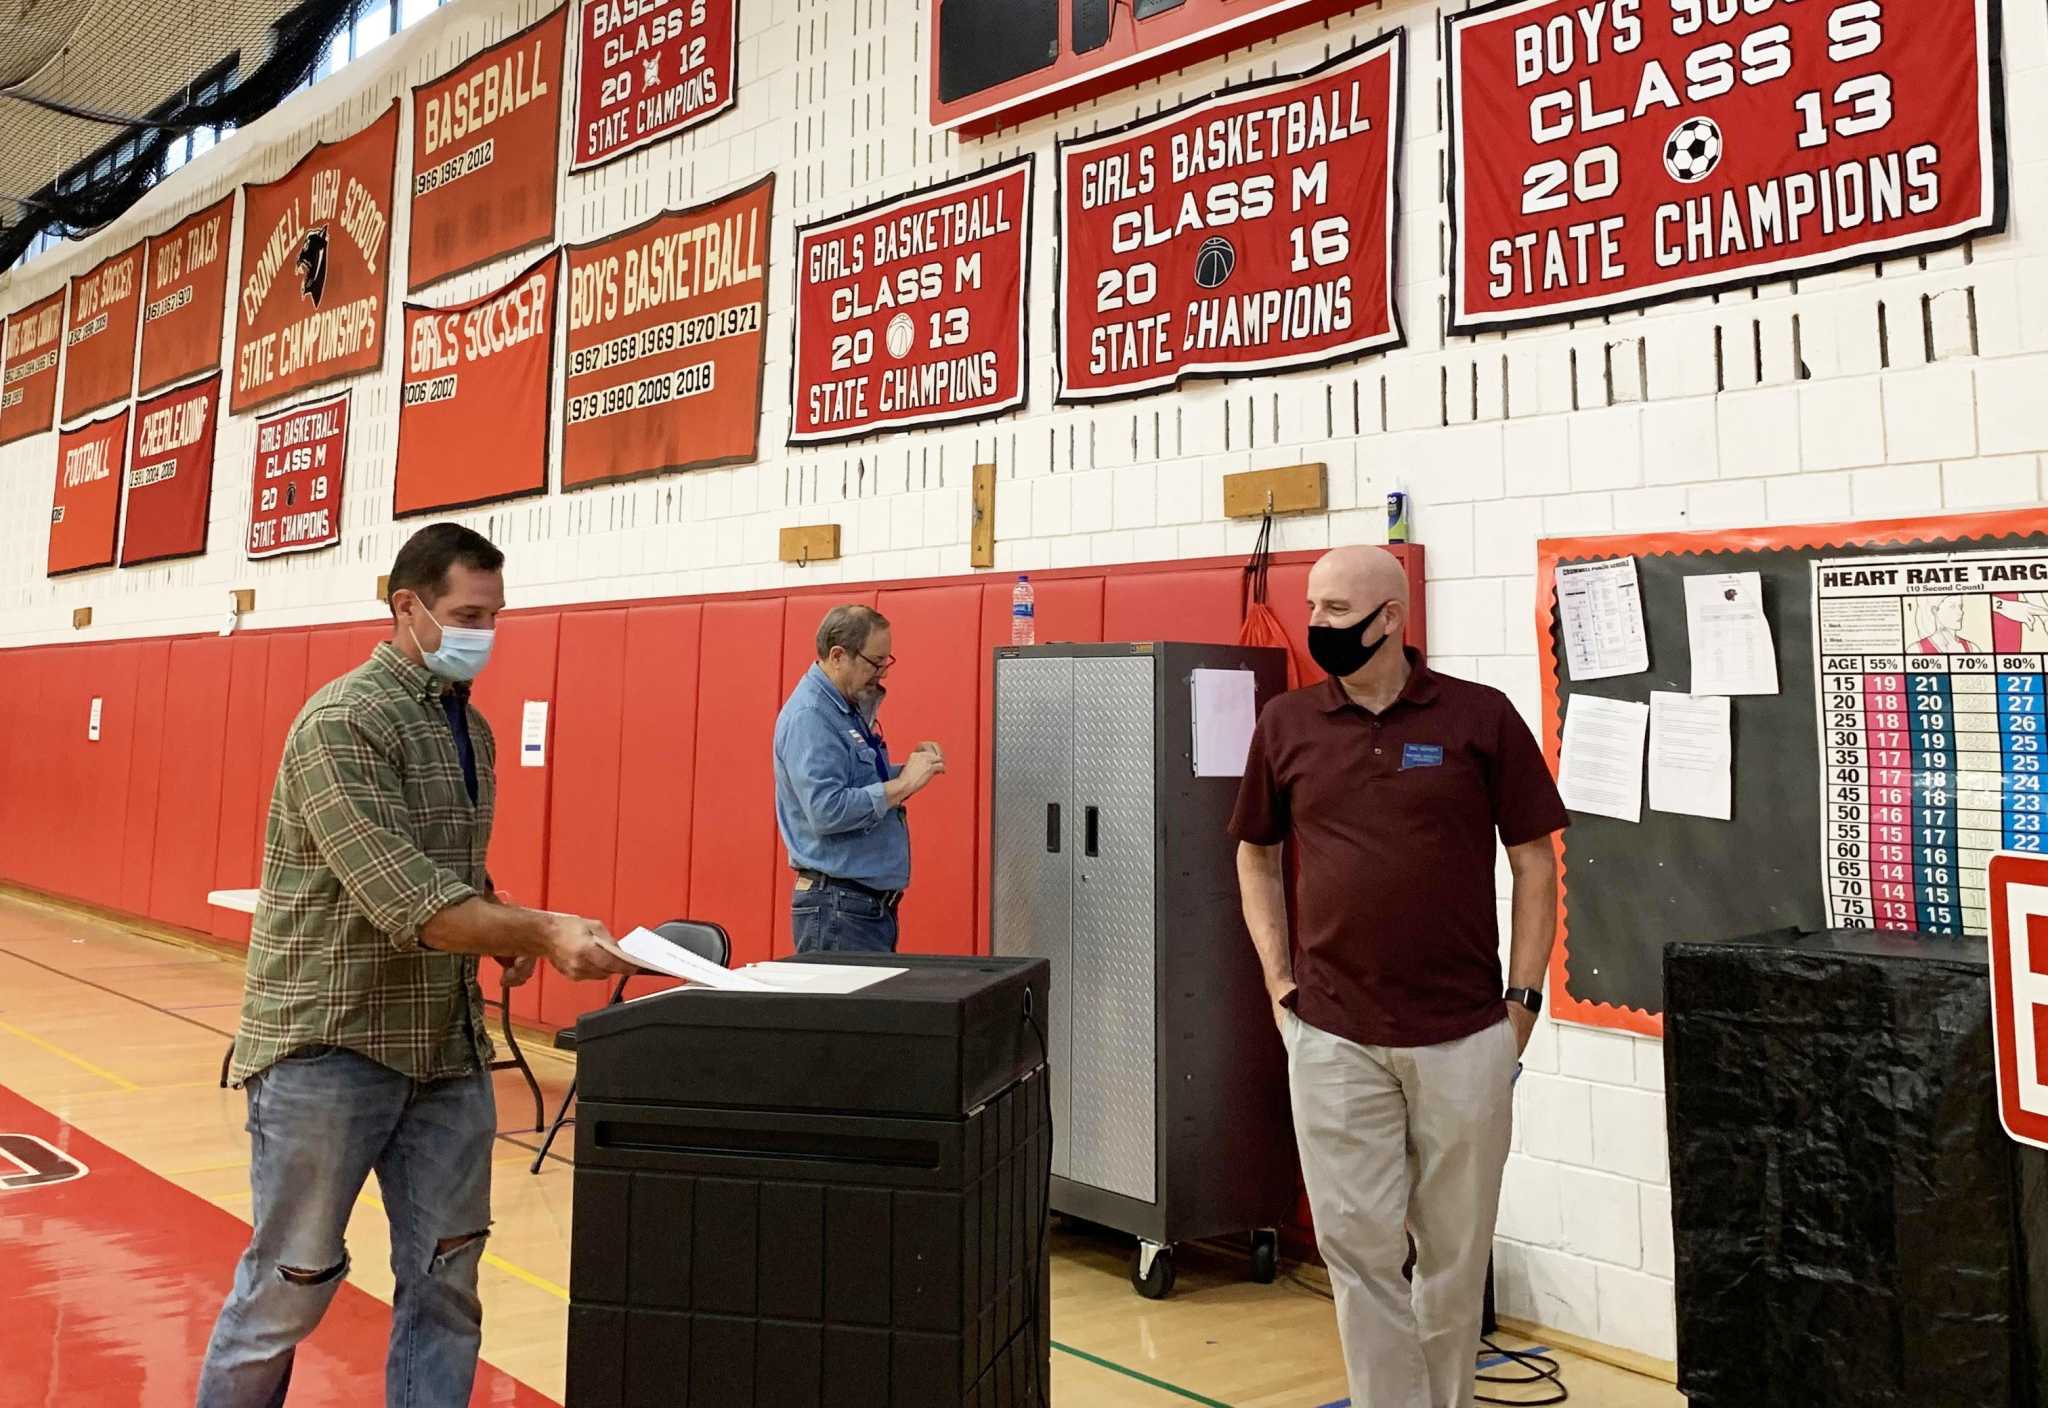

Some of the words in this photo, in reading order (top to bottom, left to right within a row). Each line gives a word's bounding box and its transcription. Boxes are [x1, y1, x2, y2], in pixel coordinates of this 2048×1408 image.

[604, 8, 683, 69] CLASS
[690, 0, 706, 28] S
[1515, 2, 1642, 87] BOYS
[425, 40, 548, 156] BASEBALL
[601, 71, 632, 109] 20
[679, 36, 706, 75] 12
[1529, 23, 1792, 145] CLASS
[1828, 0, 1883, 63] S
[589, 107, 630, 155] STATE
[636, 67, 717, 135] CHAMPIONS
[440, 156, 464, 185] 1967
[467, 141, 492, 172] 2012
[1081, 145, 1155, 210] GIRLS
[1171, 80, 1371, 184] BASKETBALL
[1522, 145, 1618, 216] 20
[1795, 73, 1893, 150] 13
[1112, 174, 1275, 255] CLASS
[1291, 160, 1329, 212] M
[1489, 216, 1625, 299] STATE
[1654, 144, 1939, 268] CHAMPIONS
[156, 238, 183, 289] BOYS
[186, 216, 221, 274] TRACK
[242, 197, 304, 326] CROMWELL
[310, 169, 341, 224] HIGH
[341, 177, 387, 275] SCHOOL
[809, 233, 865, 284] GIRLS
[874, 189, 1011, 267] BASKETBALL
[1096, 262, 1158, 313] 20
[1289, 216, 1350, 273] 16
[77, 275, 100, 322] BOYS
[100, 257, 134, 309] SOCCER
[570, 256, 619, 331] BOYS
[623, 207, 762, 316] BASKETBALL
[831, 262, 943, 323] CLASS
[955, 252, 982, 293] M
[411, 312, 460, 374] GIRLS
[463, 273, 546, 362] SOCCER
[604, 336, 636, 366] 1968
[641, 325, 674, 355] 1969
[679, 316, 715, 347] 1970
[719, 305, 757, 337] 1971
[831, 328, 874, 372] 20
[929, 306, 970, 349] 13
[1089, 312, 1174, 376] STATE
[1183, 275, 1352, 352] CHAMPIONS
[240, 332, 277, 392] STATE
[431, 377, 455, 400] 2007
[602, 385, 634, 415] 1980
[638, 376, 671, 406] 2009
[676, 364, 711, 395] 2018
[809, 376, 869, 425] STATE
[879, 350, 997, 412] CHAMPIONS
[139, 395, 209, 458] CHEERLEADING
[283, 407, 340, 448] BASKETBALL
[63, 436, 111, 489] FOOTBALL
[265, 447, 312, 479] CLASS
[314, 444, 327, 468] M
[261, 487, 278, 512] 20
[310, 476, 328, 502] 19
[252, 518, 277, 549] STATE
[280, 508, 329, 543] CHAMPIONS
[1823, 570, 1899, 588] HEART
[1906, 567, 1968, 584] RATE
[1996, 600, 2004, 610] 2
[1828, 658, 1858, 669] AGE
[1869, 658, 1898, 669] 55%
[1911, 658, 1942, 669] 60%
[1957, 658, 1988, 669] 70%
[2003, 657, 2036, 669] 80%
[1833, 676, 1855, 691] 15
[1874, 676, 1897, 690] 19
[1915, 676, 1938, 692] 21
[2007, 676, 2033, 692] 27
[1833, 695, 1856, 710] 20
[1874, 695, 1897, 710] 18
[1917, 695, 1942, 711] 20
[2008, 695, 2034, 712] 27
[1834, 713, 1857, 728] 25
[1876, 714, 1899, 729] 18
[1920, 714, 1944, 730] 19
[2010, 715, 2036, 732] 26
[1835, 732, 1858, 746] 30
[1877, 733, 1899, 747] 17
[1921, 733, 1945, 749] 19
[2011, 735, 2038, 751] 25
[1836, 750, 1859, 765] 35
[1878, 751, 1901, 766] 17
[1922, 752, 1946, 768] 19
[2013, 755, 2040, 771] 25
[1837, 769, 1859, 783] 40
[1880, 770, 1901, 784] 17
[2013, 775, 2040, 791] 24
[1837, 787, 1860, 801] 45
[1880, 789, 1902, 803] 16
[1923, 790, 1946, 806] 18
[2013, 795, 2040, 811] 23
[1838, 805, 1860, 820] 50
[1880, 807, 1902, 823] 16
[1923, 810, 1946, 825] 17
[2013, 815, 2040, 831] 23
[1838, 824, 1860, 839] 55
[1880, 826, 1902, 842] 15
[1923, 829, 1946, 845] 17
[2013, 834, 2040, 851] 22
[1838, 843, 1860, 858] 60
[1880, 845, 1903, 861] 15
[1923, 848, 1947, 864] 16
[1838, 862, 1860, 877] 65
[1880, 864, 1904, 880] 14
[1924, 868, 1948, 884] 16
[1839, 880, 1862, 896] 70
[1881, 883, 1905, 899] 14
[1925, 888, 1949, 904] 15
[1841, 899, 1864, 914] 75
[1883, 903, 1906, 918] 13
[1927, 907, 1951, 923] 15
